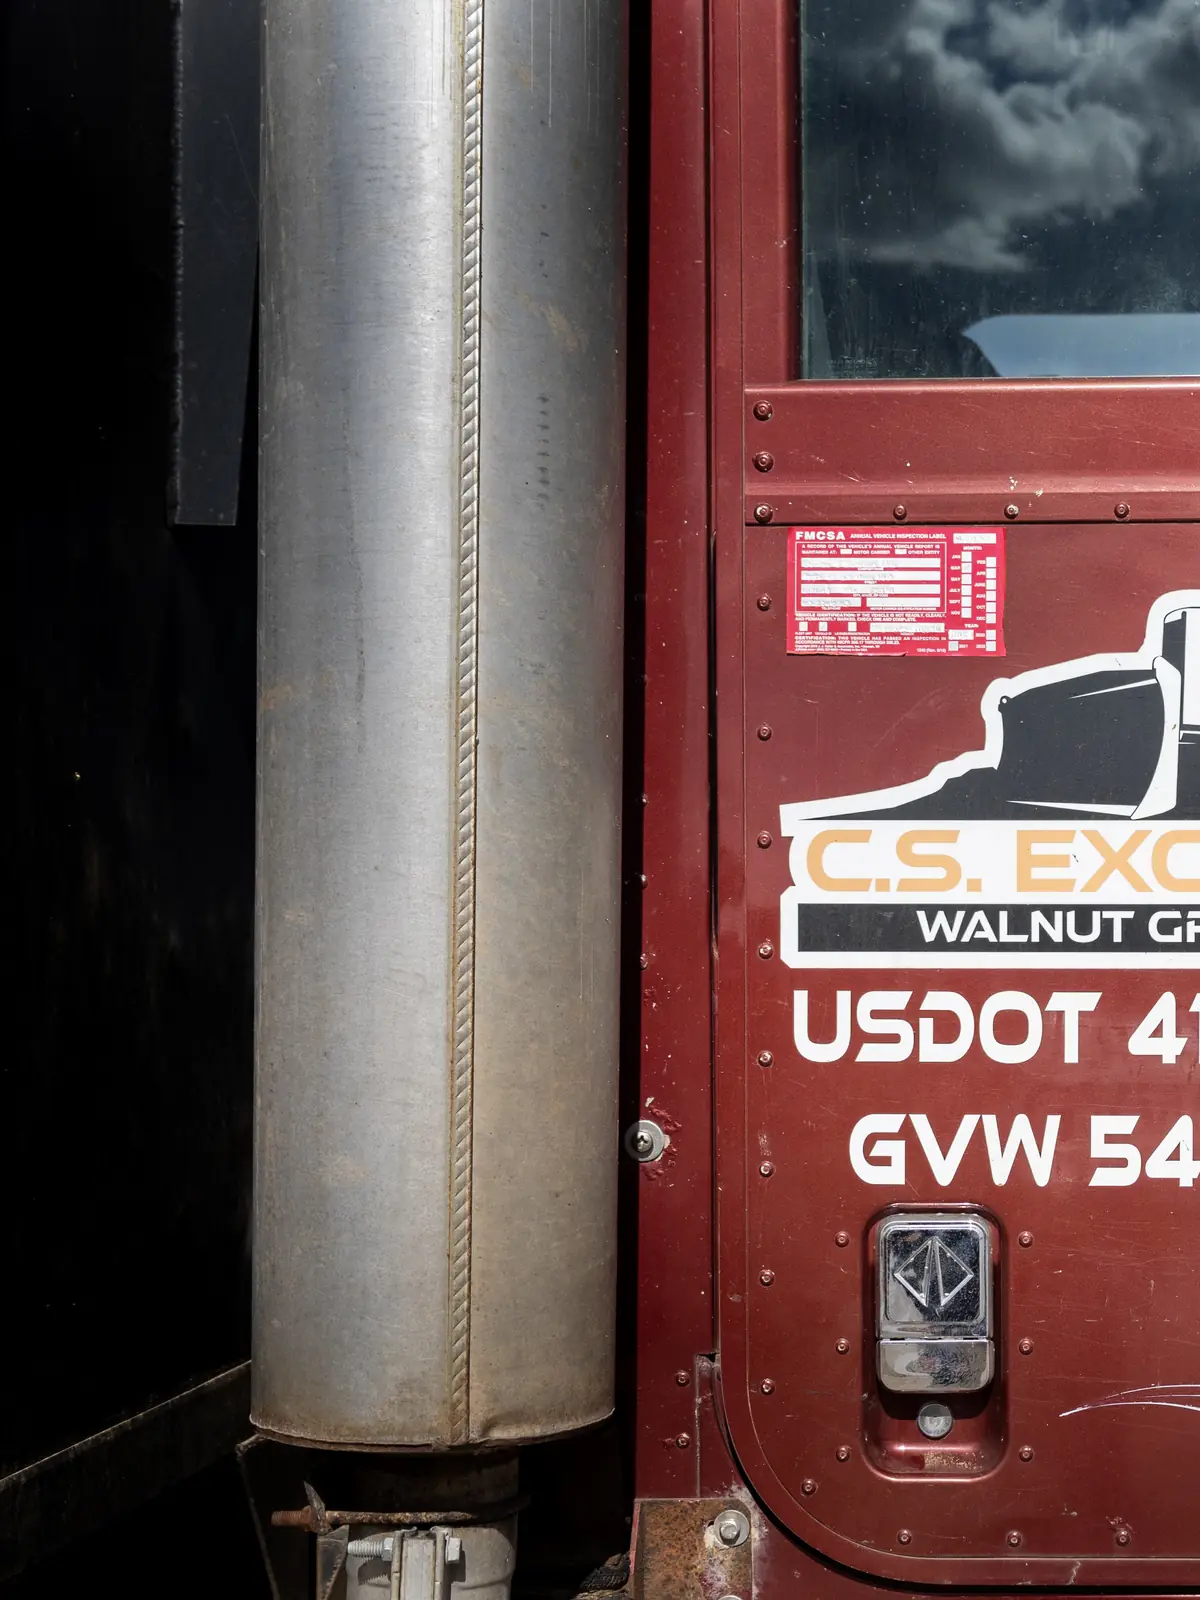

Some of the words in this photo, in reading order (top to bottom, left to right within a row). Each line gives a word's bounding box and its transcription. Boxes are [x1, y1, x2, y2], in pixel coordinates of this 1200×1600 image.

[795, 531, 845, 540] FMCSA
[806, 829, 982, 893] C.S.
[916, 910, 1135, 943] WALNUT
[793, 990, 1102, 1064] USDOT
[848, 1113, 1062, 1187] GVW
